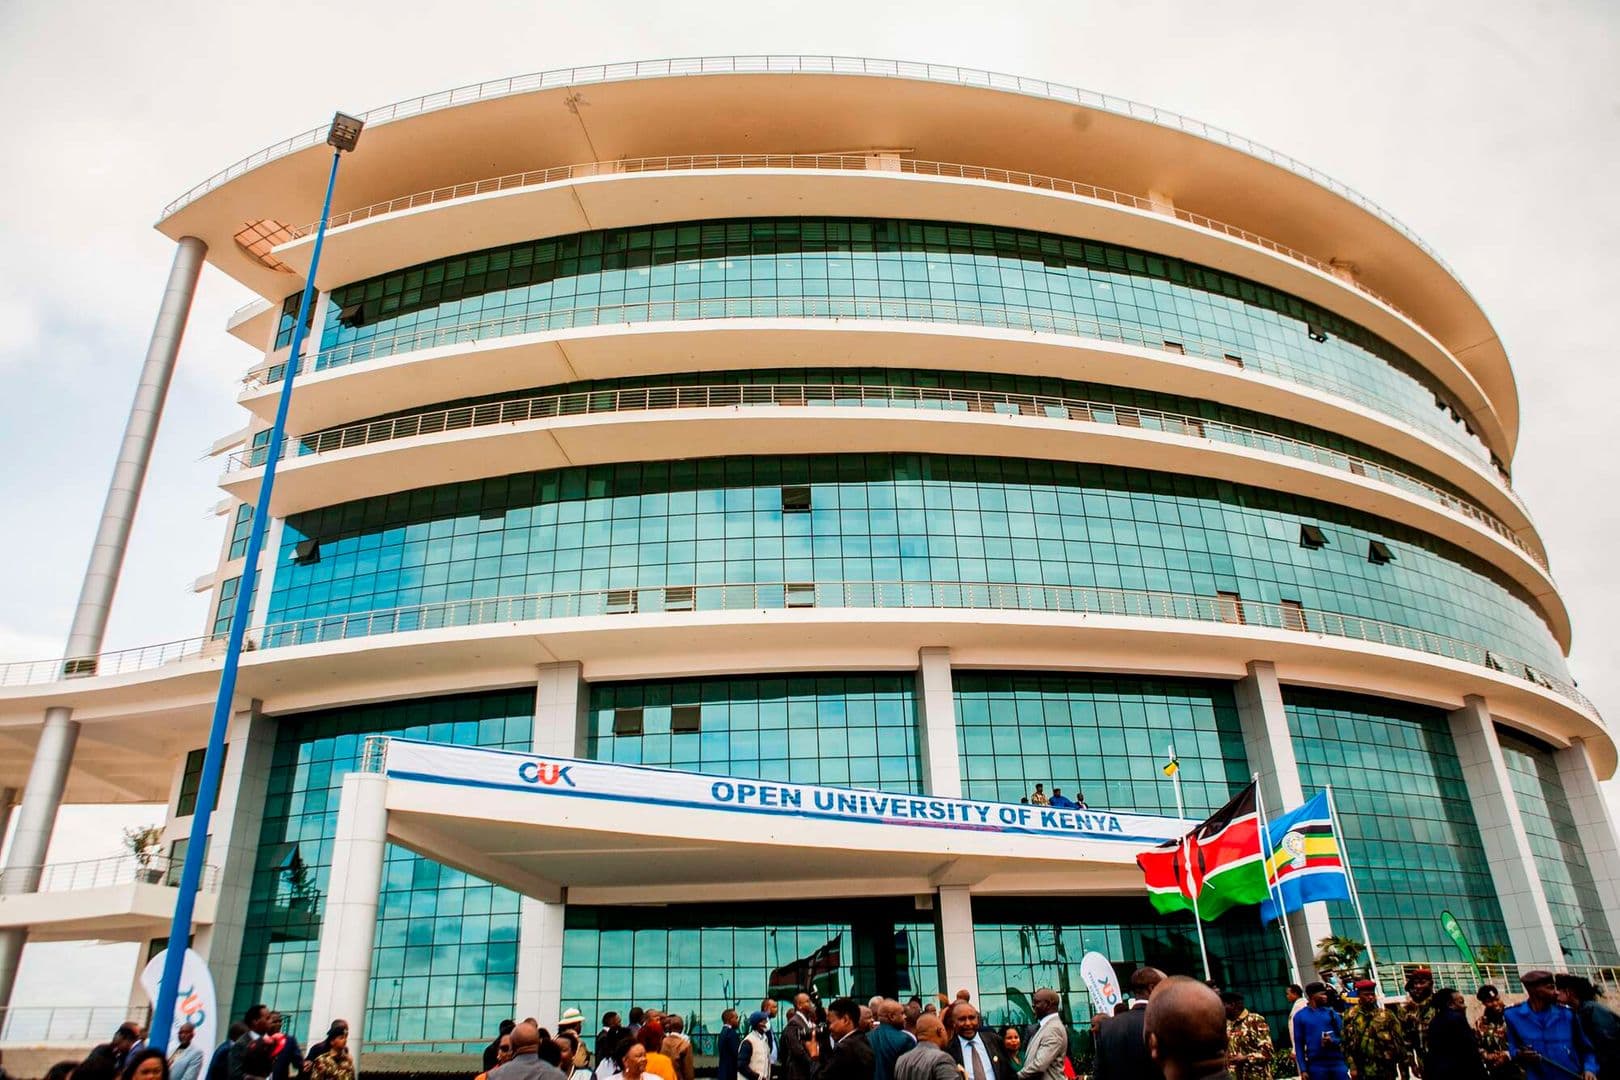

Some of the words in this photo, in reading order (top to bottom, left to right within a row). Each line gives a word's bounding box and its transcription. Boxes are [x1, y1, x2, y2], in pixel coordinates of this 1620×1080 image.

[519, 762, 576, 787] CUK
[711, 781, 801, 808] OPEN
[814, 790, 990, 823] UNIVERSITY
[998, 807, 1031, 826] OF
[1041, 811, 1124, 833] KENYA
